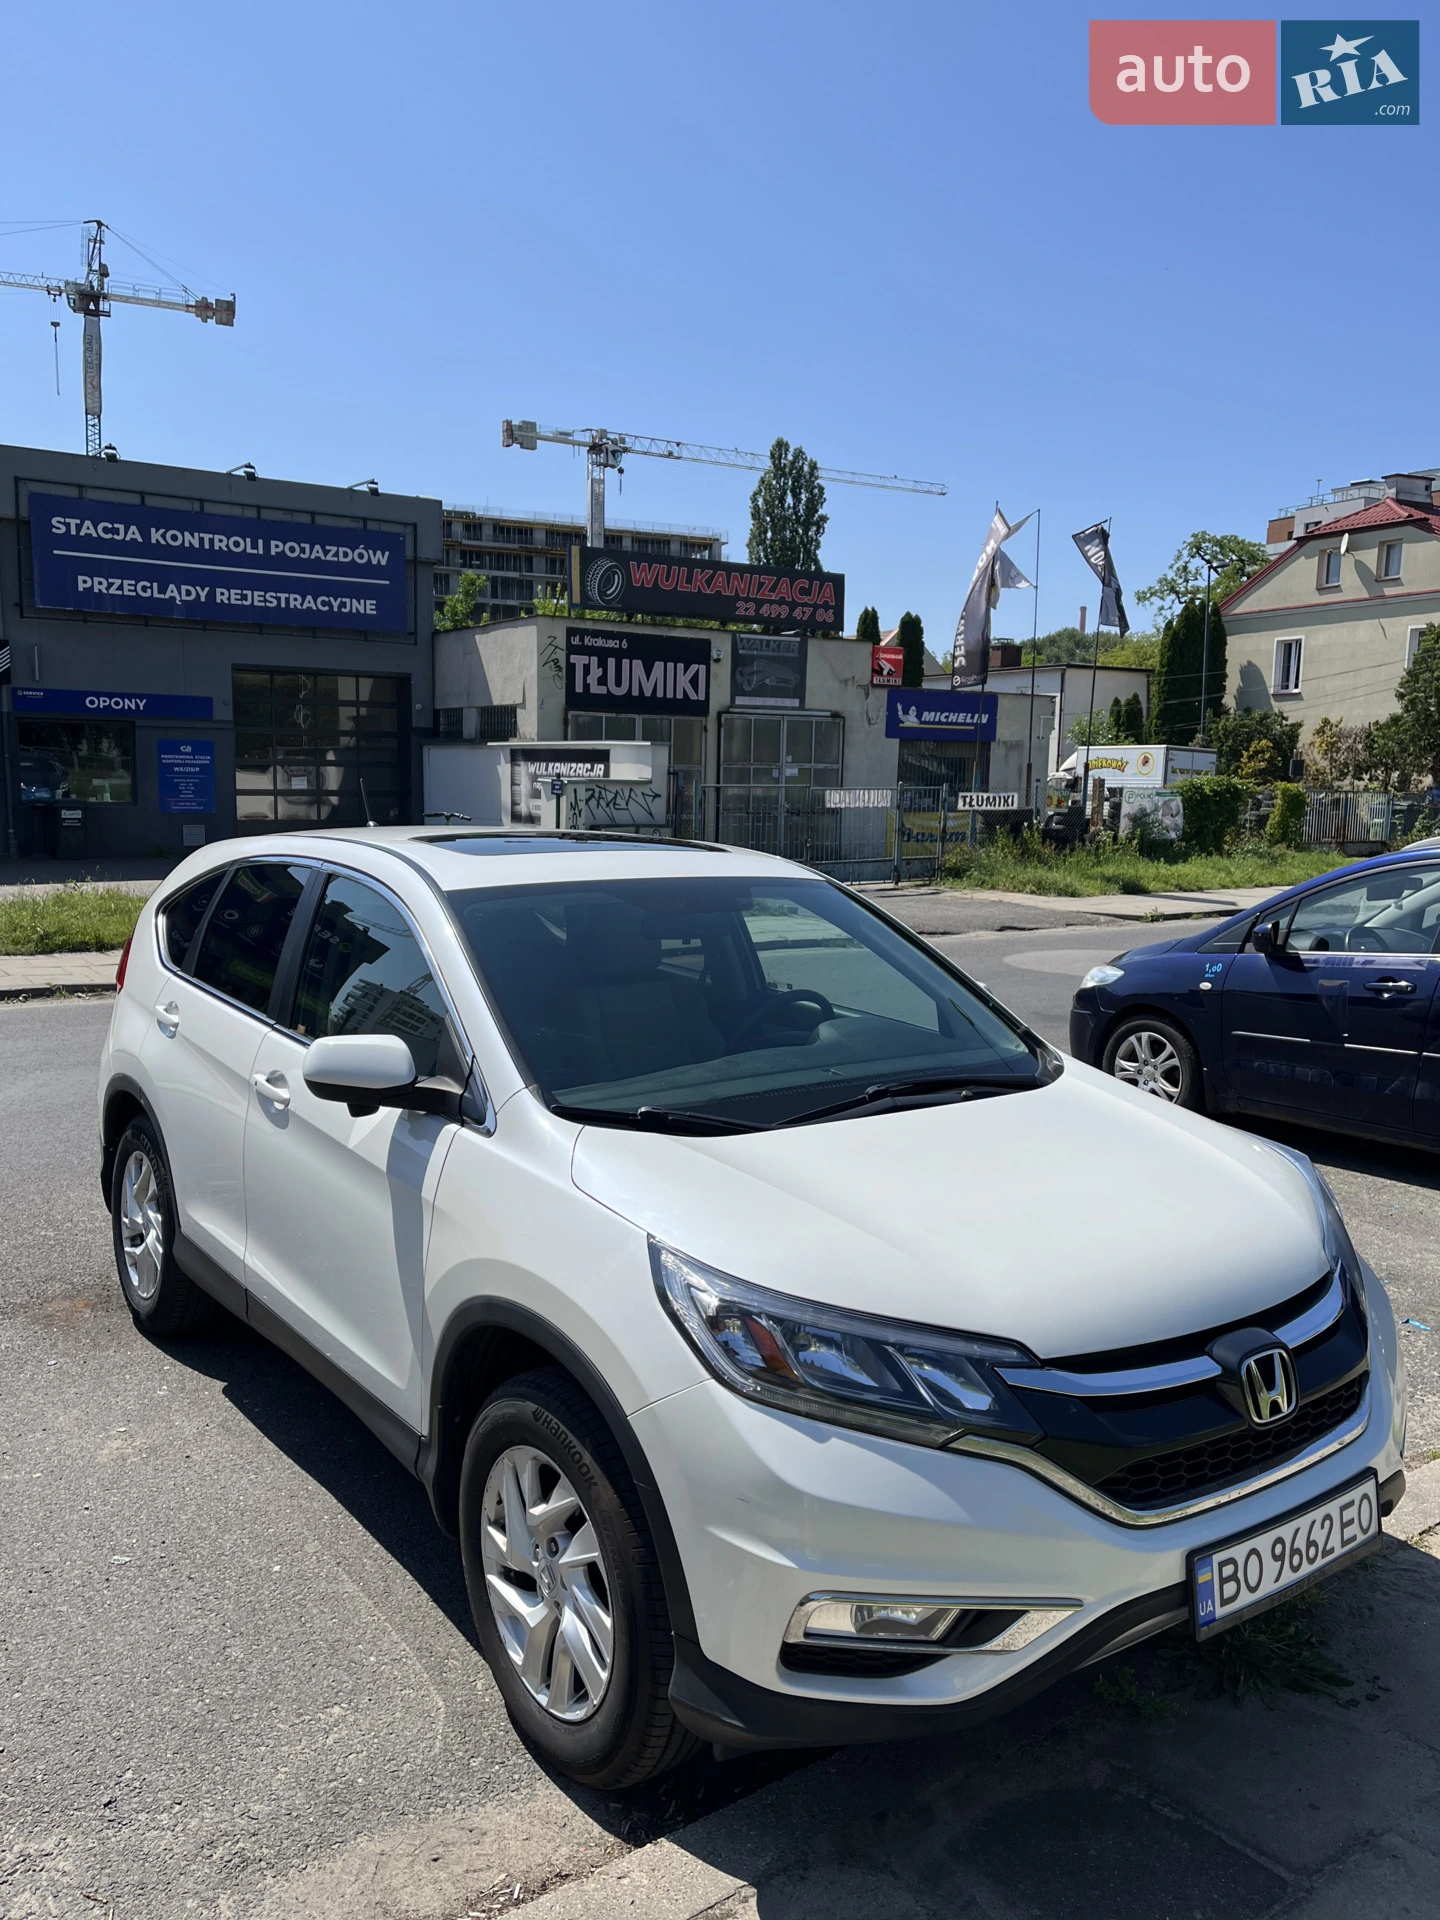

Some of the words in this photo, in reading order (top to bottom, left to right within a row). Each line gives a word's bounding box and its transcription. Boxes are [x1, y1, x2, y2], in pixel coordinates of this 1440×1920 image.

[51, 516, 143, 543] STACJA
[150, 527, 264, 555] KONTROLI
[270, 540, 389, 566] POJAZDÓW
[629, 561, 836, 606] WULKANIZACJA
[77, 575, 210, 605] PRZEGLĄDY
[215, 587, 377, 615] REJESTRACYJNE
[735, 601, 756, 616] 22
[760, 603, 789, 619] 499
[792, 606, 811, 621] 47
[815, 608, 835, 623] 06
[570, 635, 582, 645] ul.
[584, 635, 620, 649] Krakusa
[621, 638, 628, 649] 6
[735, 636, 799, 654] WALKER
[569, 654, 707, 701] TŁUMIKI
[85, 696, 147, 711] OPONY
[921, 711, 989, 724] MICHELIN
[528, 762, 605, 778] WULKANIZACJA
[1199, 1599, 1214, 1616] UA
[1270, 1513, 1335, 1584] 9662
